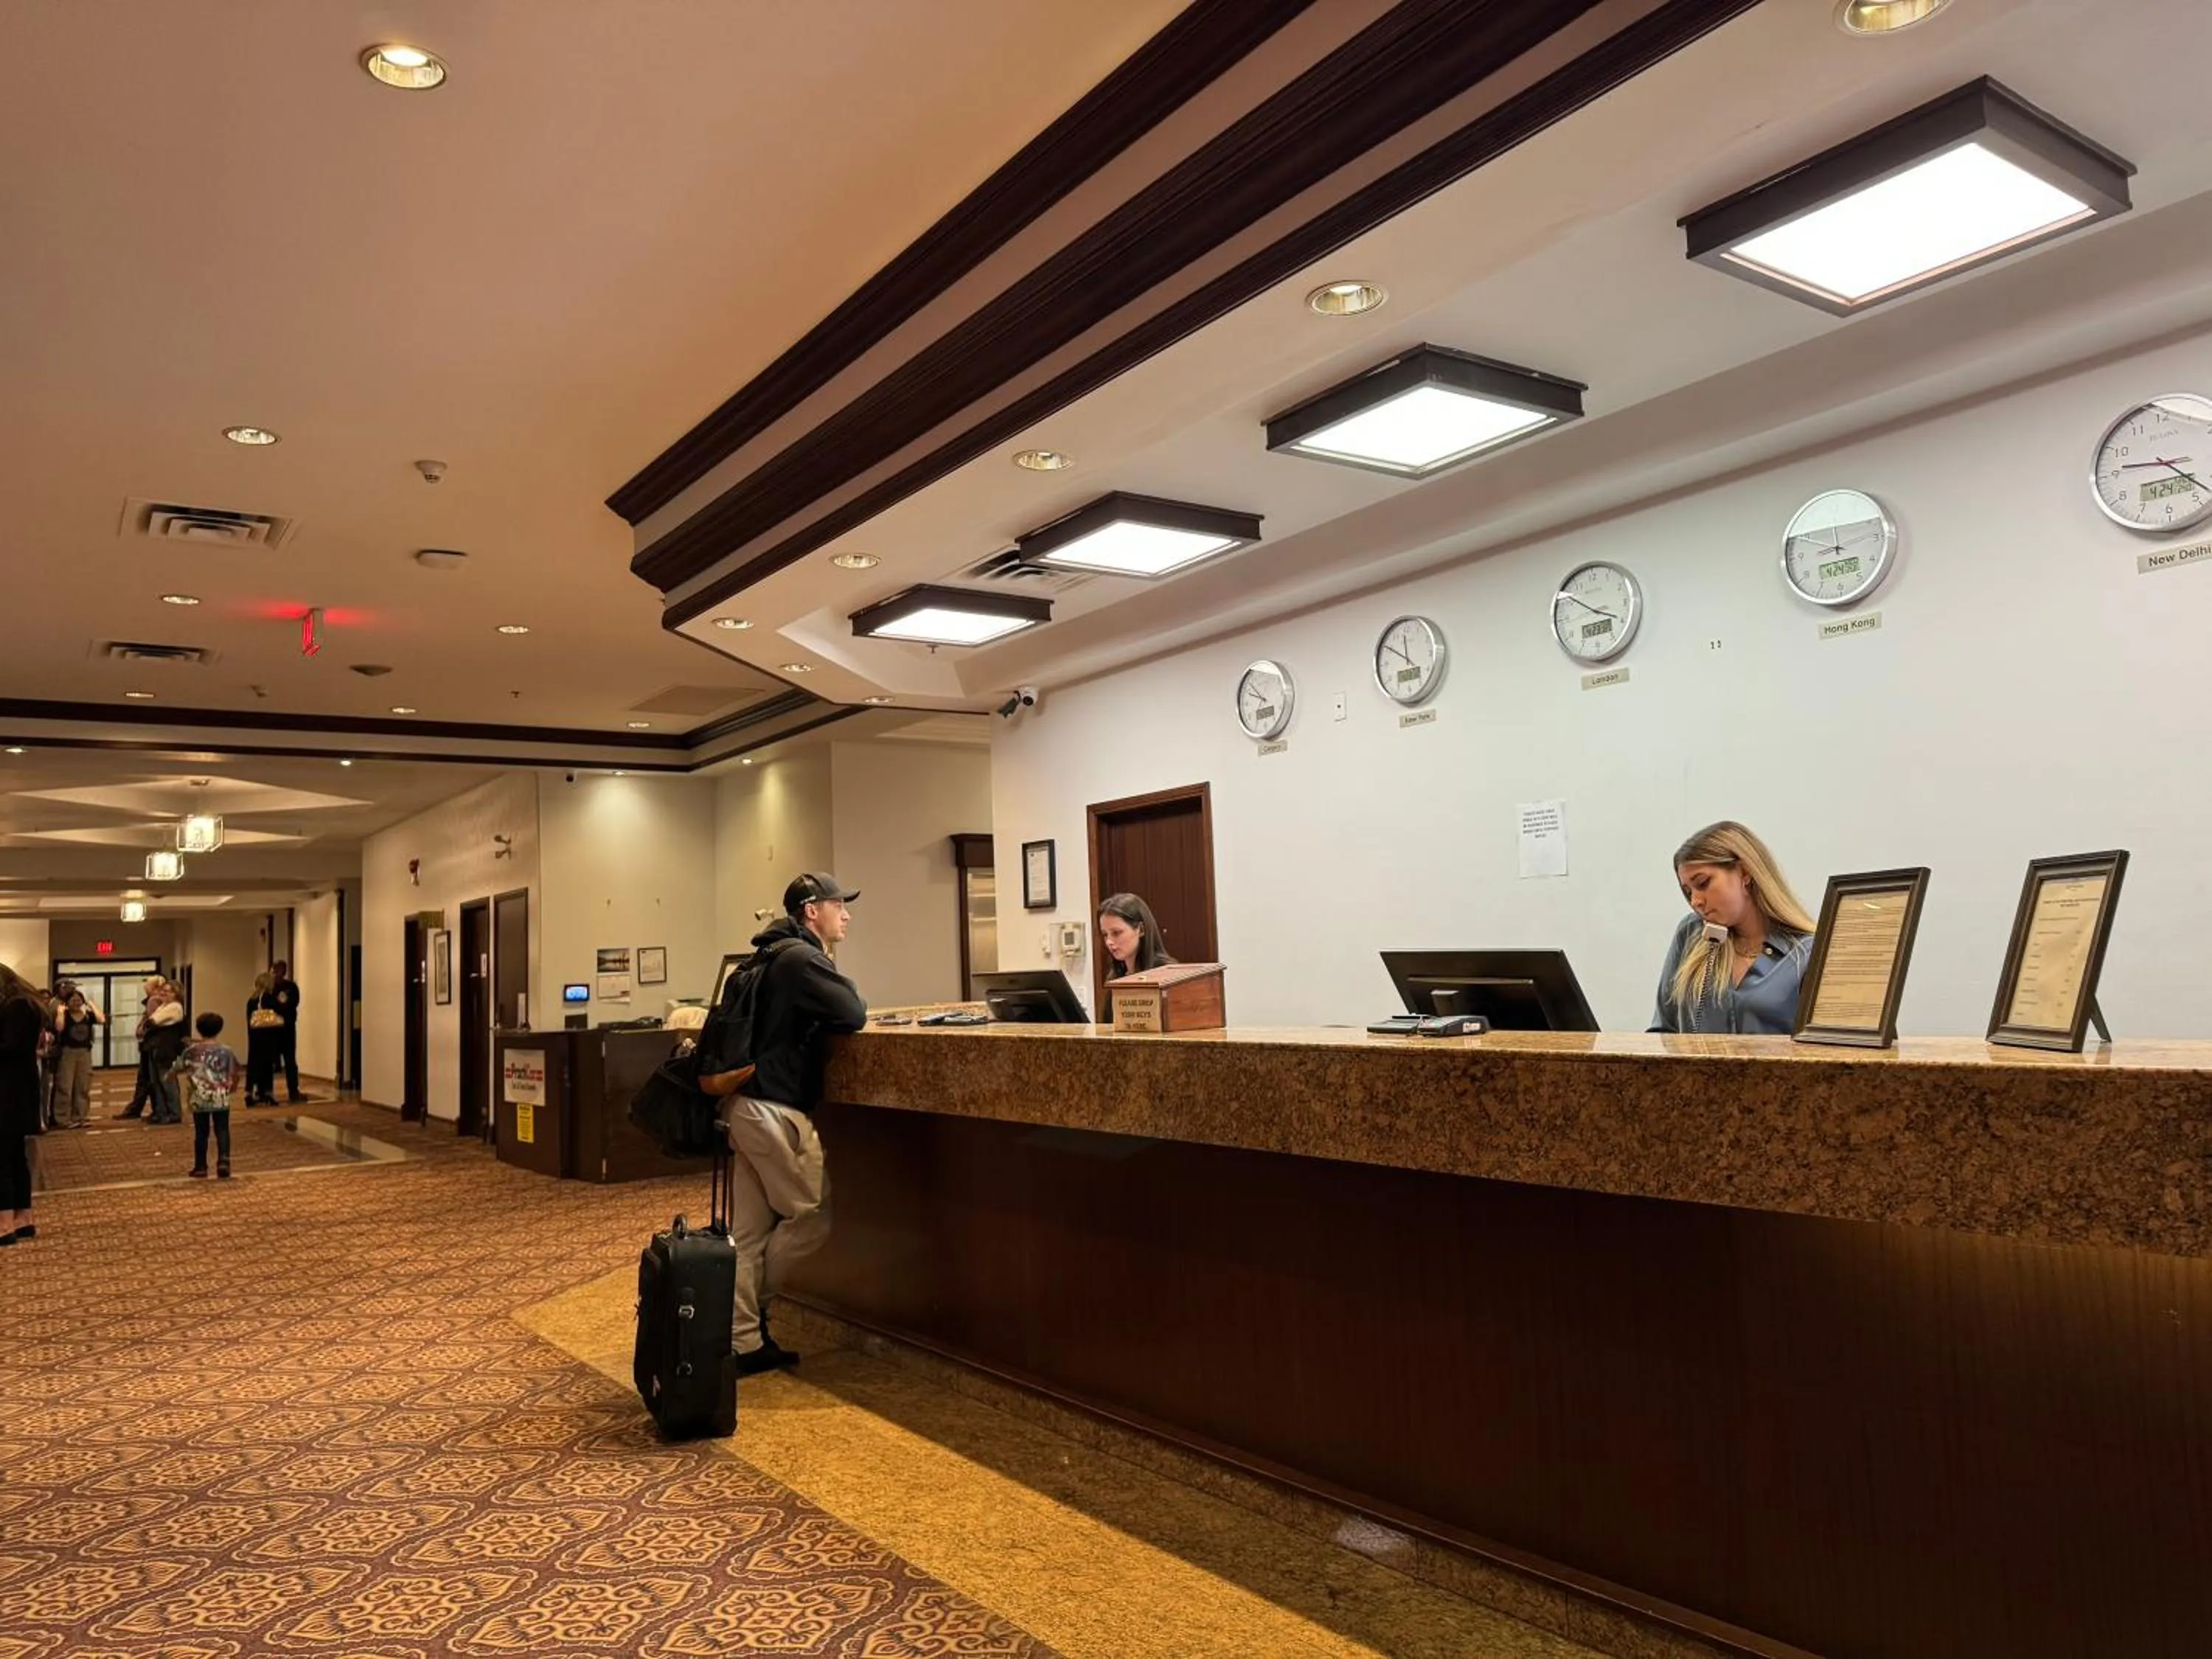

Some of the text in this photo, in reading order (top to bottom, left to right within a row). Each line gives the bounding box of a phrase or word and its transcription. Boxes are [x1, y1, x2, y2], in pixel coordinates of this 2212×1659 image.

[2156, 410, 2169, 423] 12
[2132, 425, 2144, 436] 11
[2114, 446, 2129, 458] 10
[2111, 470, 2121, 479] 9
[2118, 490, 2127, 501] 8
[2192, 493, 2200, 503] 5
[2139, 503, 2146, 513] 7
[2165, 502, 2173, 514] 6
[1873, 533, 1879, 543] 3
[2179, 544, 2211, 560] Delhi
[1856, 572, 1863, 582] 5
[1824, 618, 1875, 634] Hong Kong
